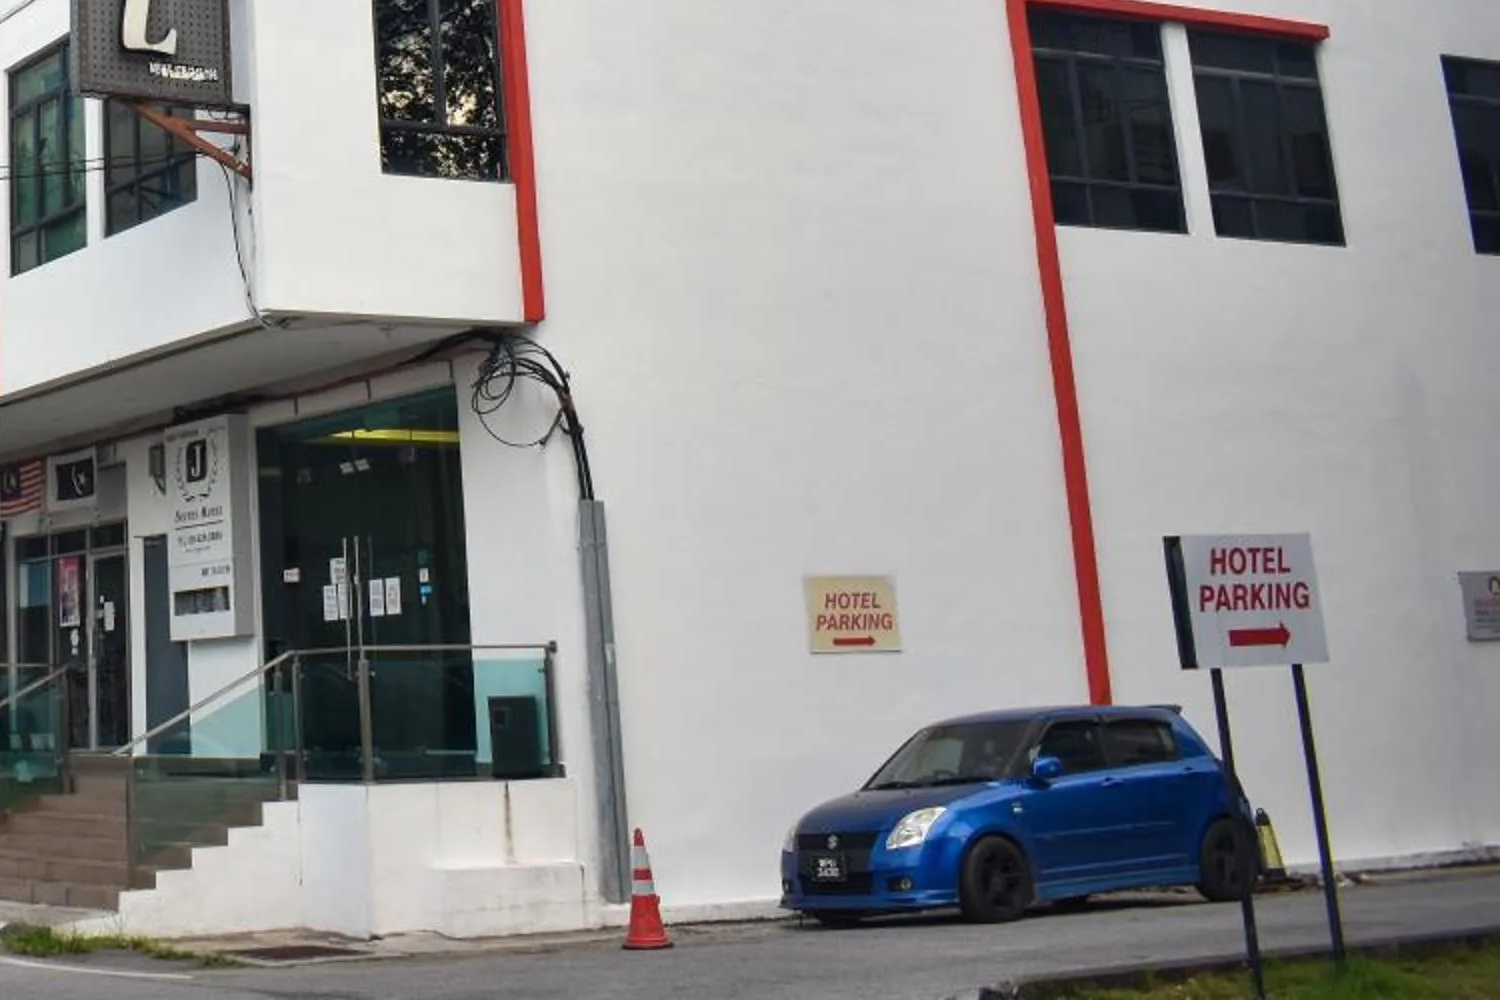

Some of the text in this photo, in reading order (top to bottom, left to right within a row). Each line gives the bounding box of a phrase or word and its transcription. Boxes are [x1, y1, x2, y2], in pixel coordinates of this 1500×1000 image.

[1211, 547, 1291, 575] HOTEL
[824, 592, 881, 609] HOTEL
[1199, 581, 1311, 613] PARKING
[815, 613, 893, 631] PARKING
